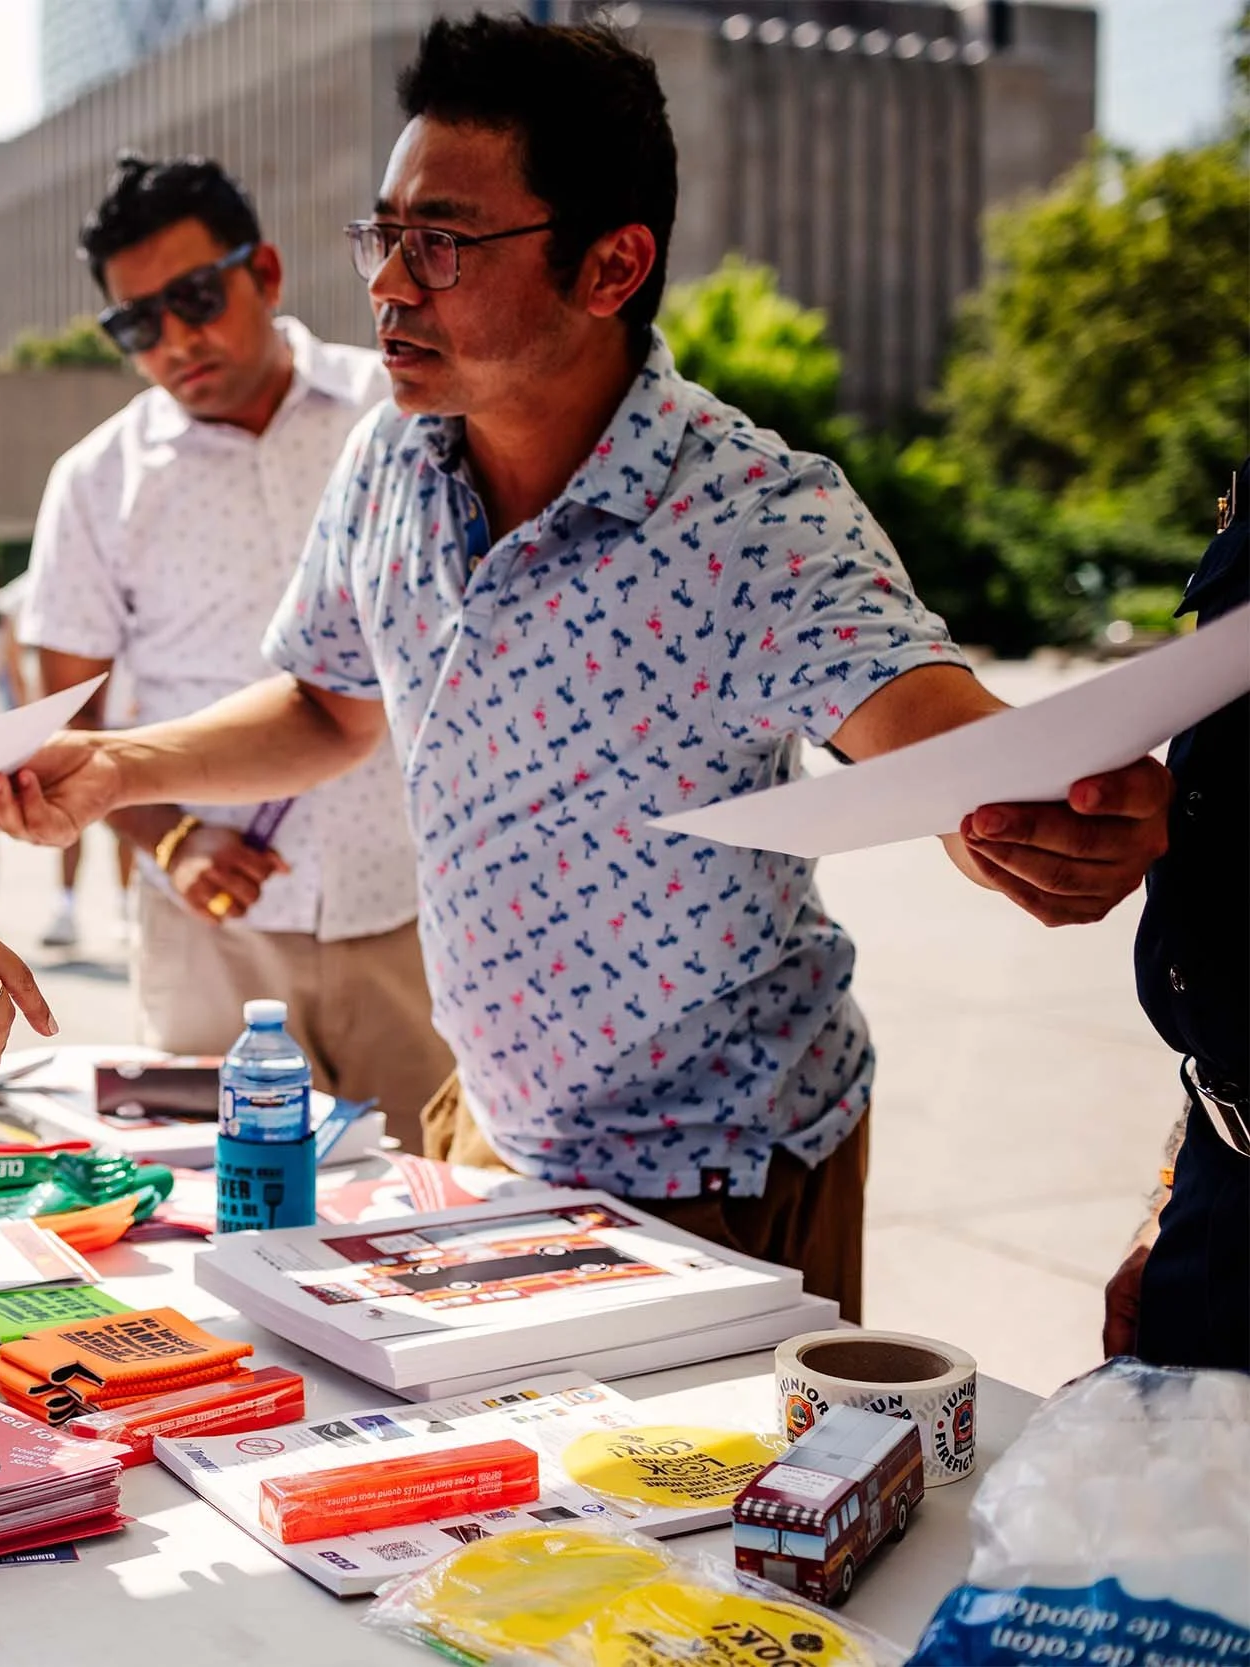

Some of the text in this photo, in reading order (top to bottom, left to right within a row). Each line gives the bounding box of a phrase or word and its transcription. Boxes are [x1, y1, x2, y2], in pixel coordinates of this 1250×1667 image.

[116, 1322, 183, 1355] JAMAIS
[780, 1377, 830, 1416] JUNIOR
[29, 1427, 60, 1442] for
[606, 1440, 694, 1459] COOK!
[664, 1453, 708, 1464] WHILE
[637, 1457, 726, 1476] LOOK
[642, 1464, 766, 1488] FIRES IN THE HOME
[711, 1462, 755, 1476] PREVENT
[455, 1473, 476, 1485] Soyez
[358, 1491, 376, 1500] vous
[378, 1486, 402, 1499] quand
[1125, 1616, 1171, 1643] de
[990, 1626, 1087, 1659] coton
[1179, 1624, 1250, 1658] olas
[1089, 1643, 1135, 1667] de
